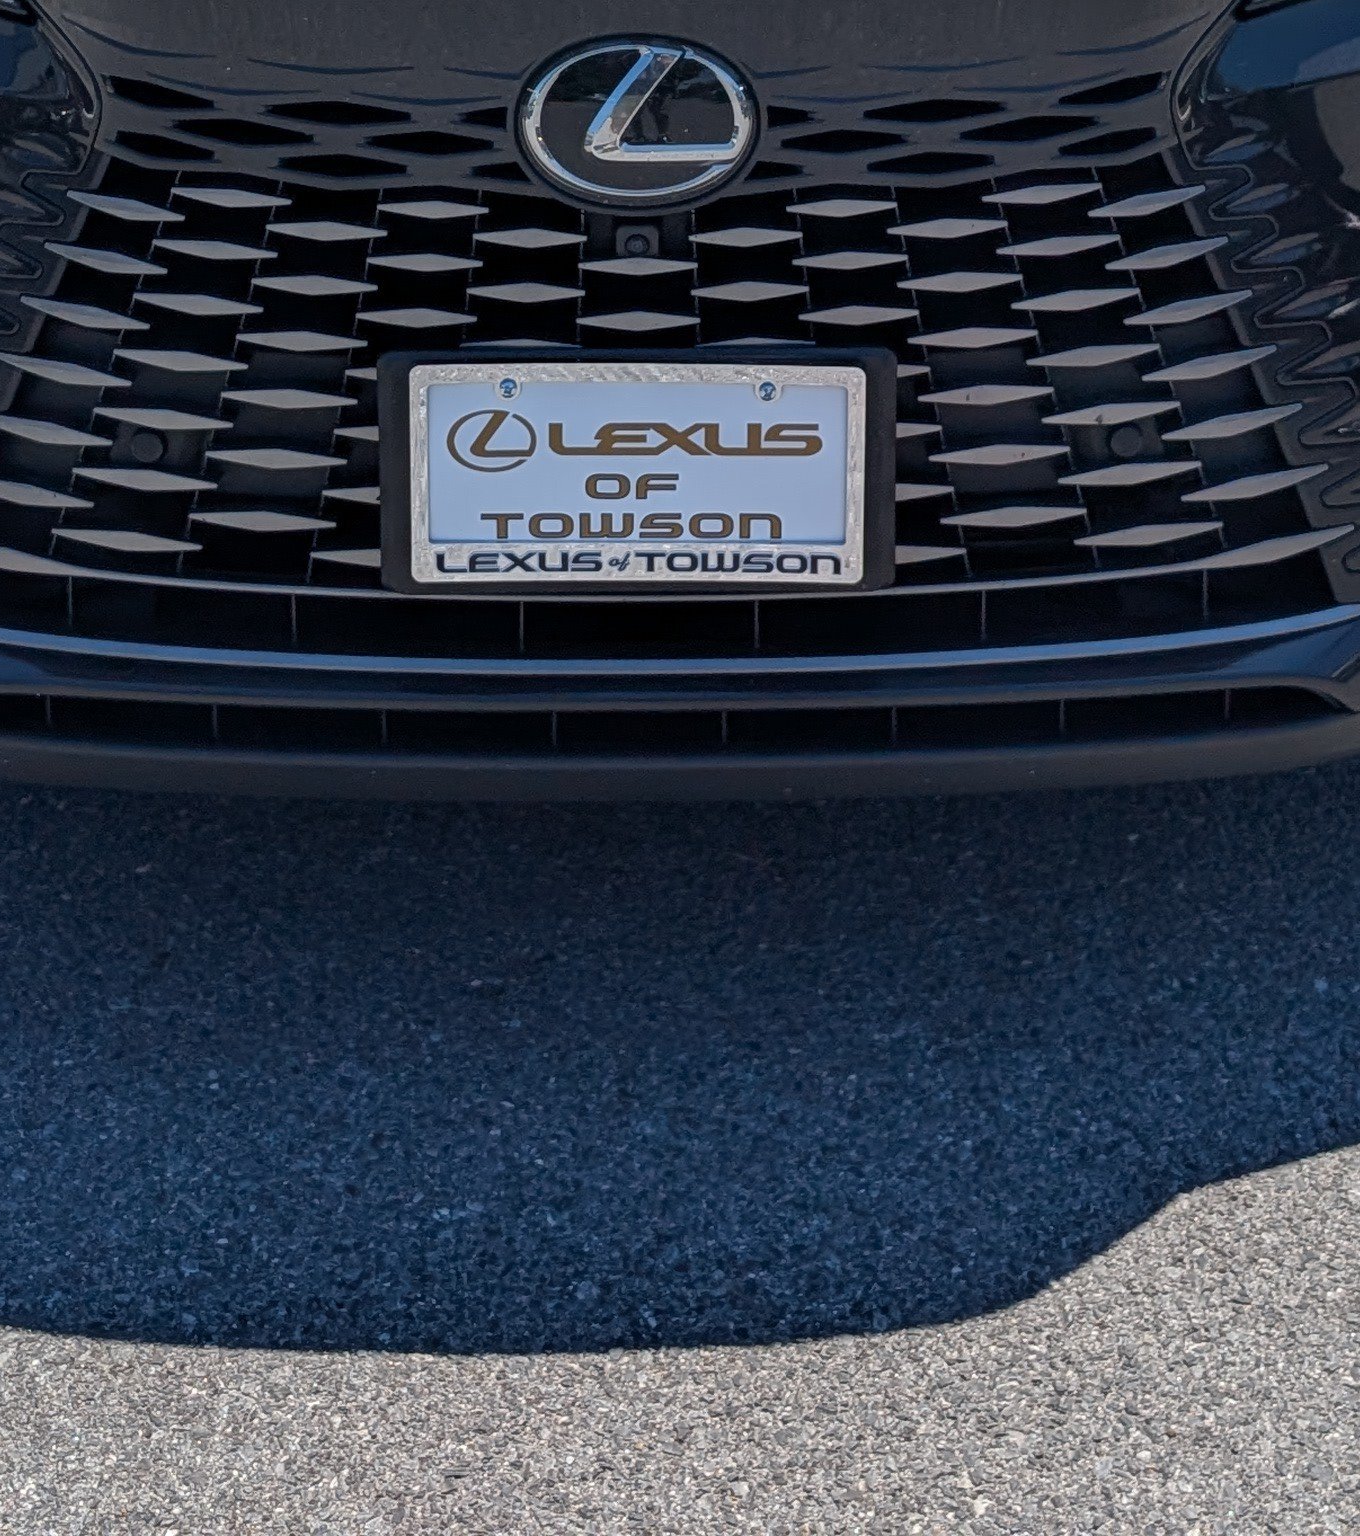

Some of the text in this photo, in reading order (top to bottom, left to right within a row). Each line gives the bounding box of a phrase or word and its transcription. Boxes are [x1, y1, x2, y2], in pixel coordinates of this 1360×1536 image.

[548, 422, 823, 456] LEXUS
[585, 473, 679, 500] OF
[480, 512, 782, 540] TOWSON
[435, 551, 842, 575] LEXUS of TOWSON
